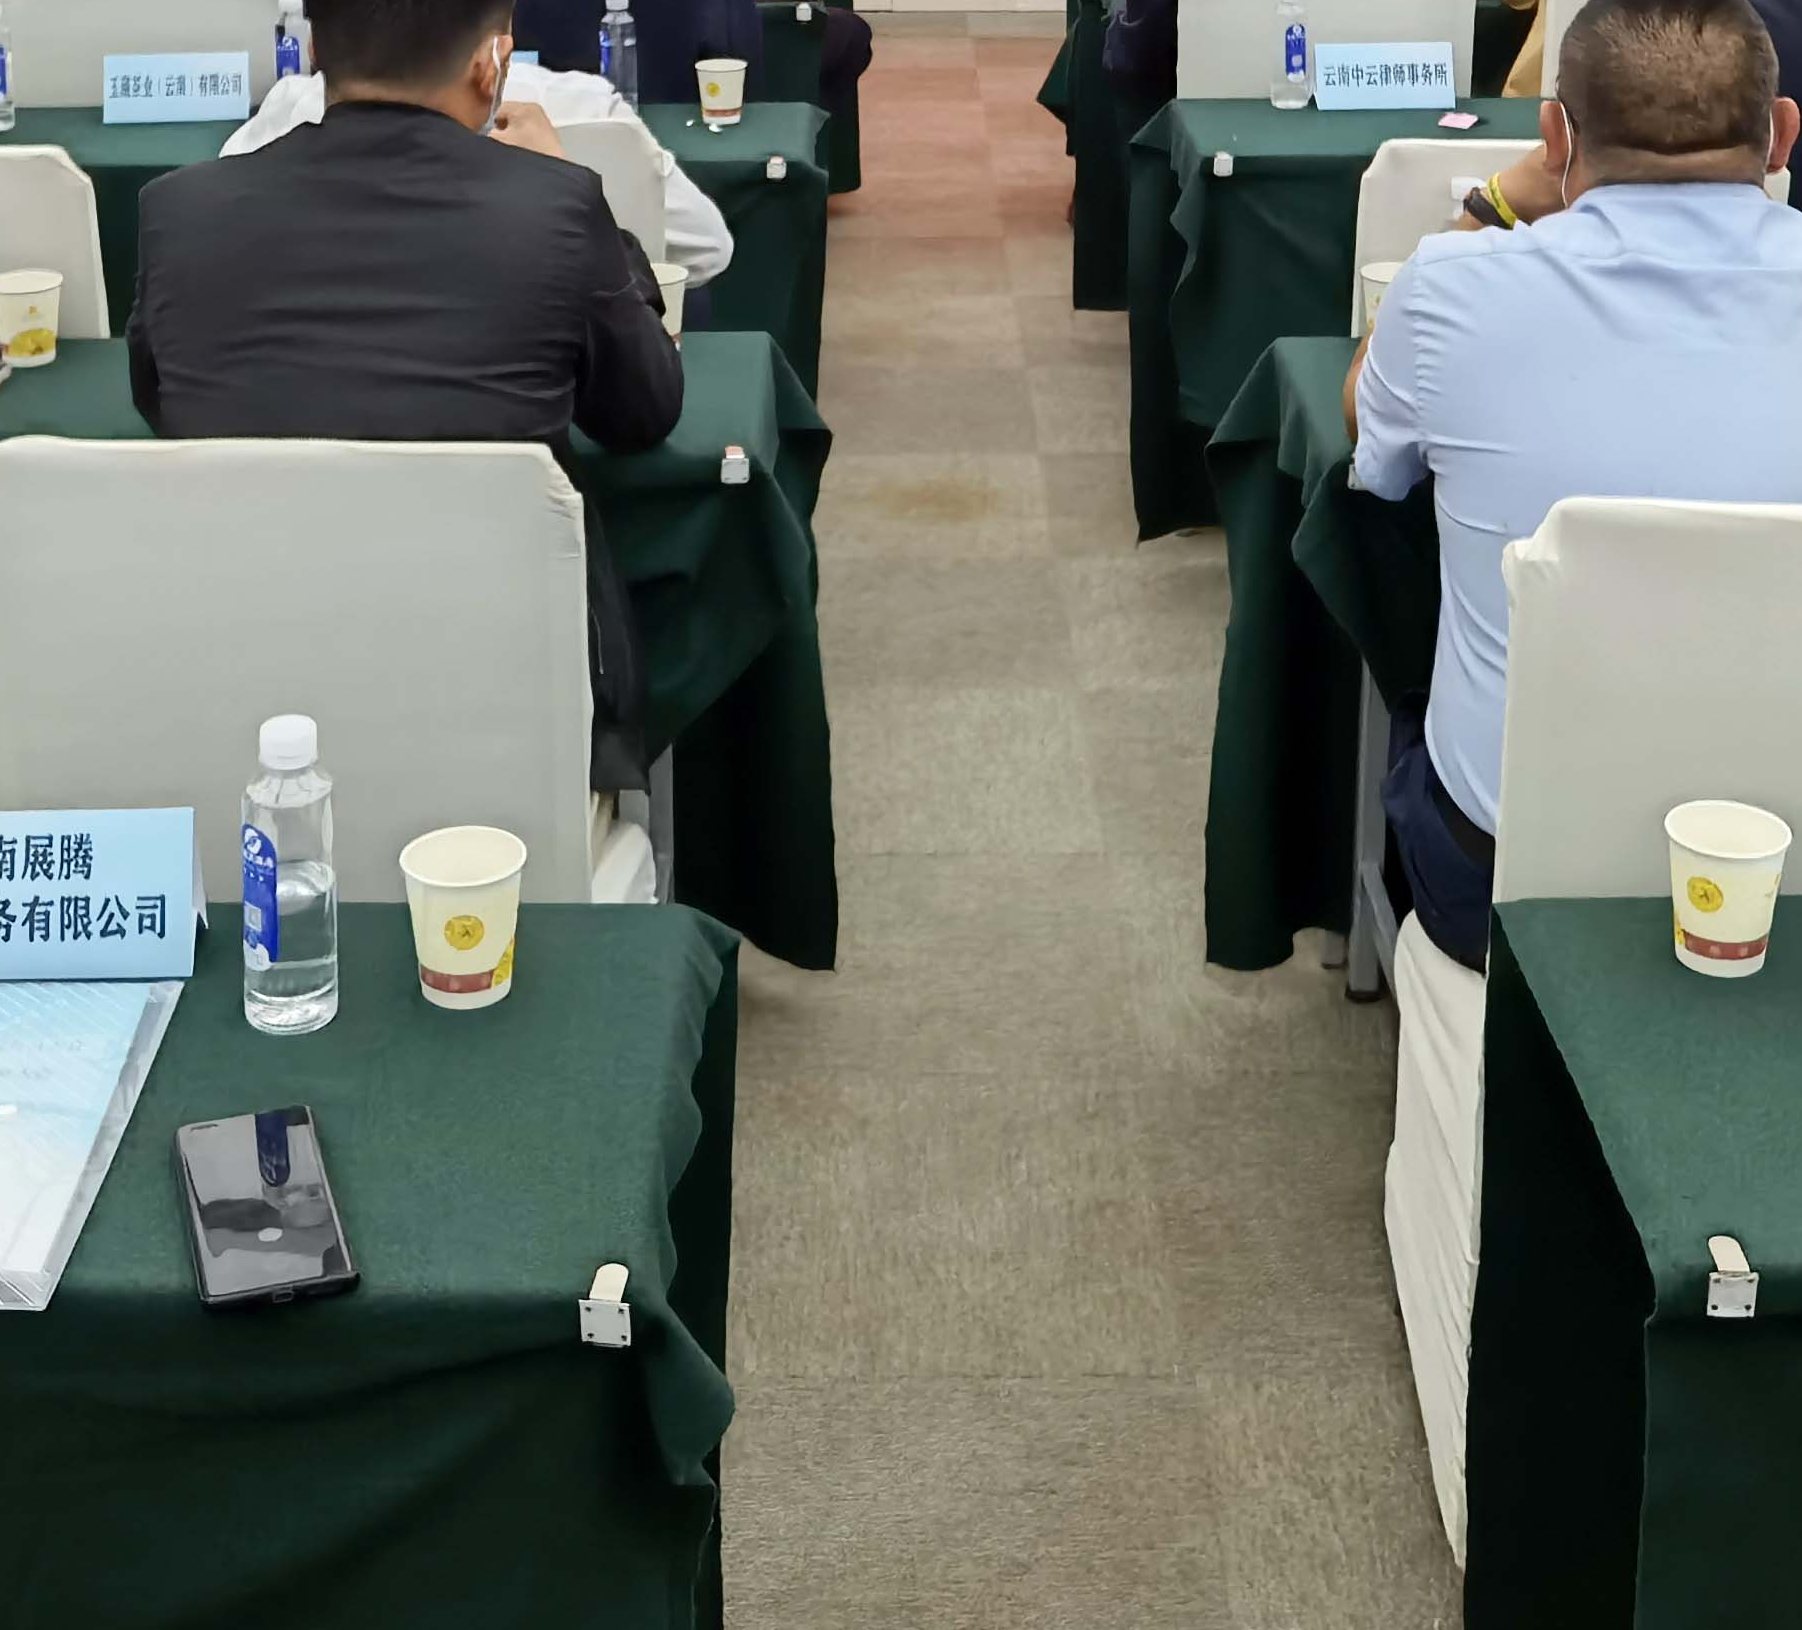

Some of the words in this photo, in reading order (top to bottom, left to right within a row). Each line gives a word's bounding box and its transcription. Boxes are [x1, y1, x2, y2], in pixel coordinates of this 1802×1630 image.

[1323, 61, 1449, 89] 云南中云律师事务所
